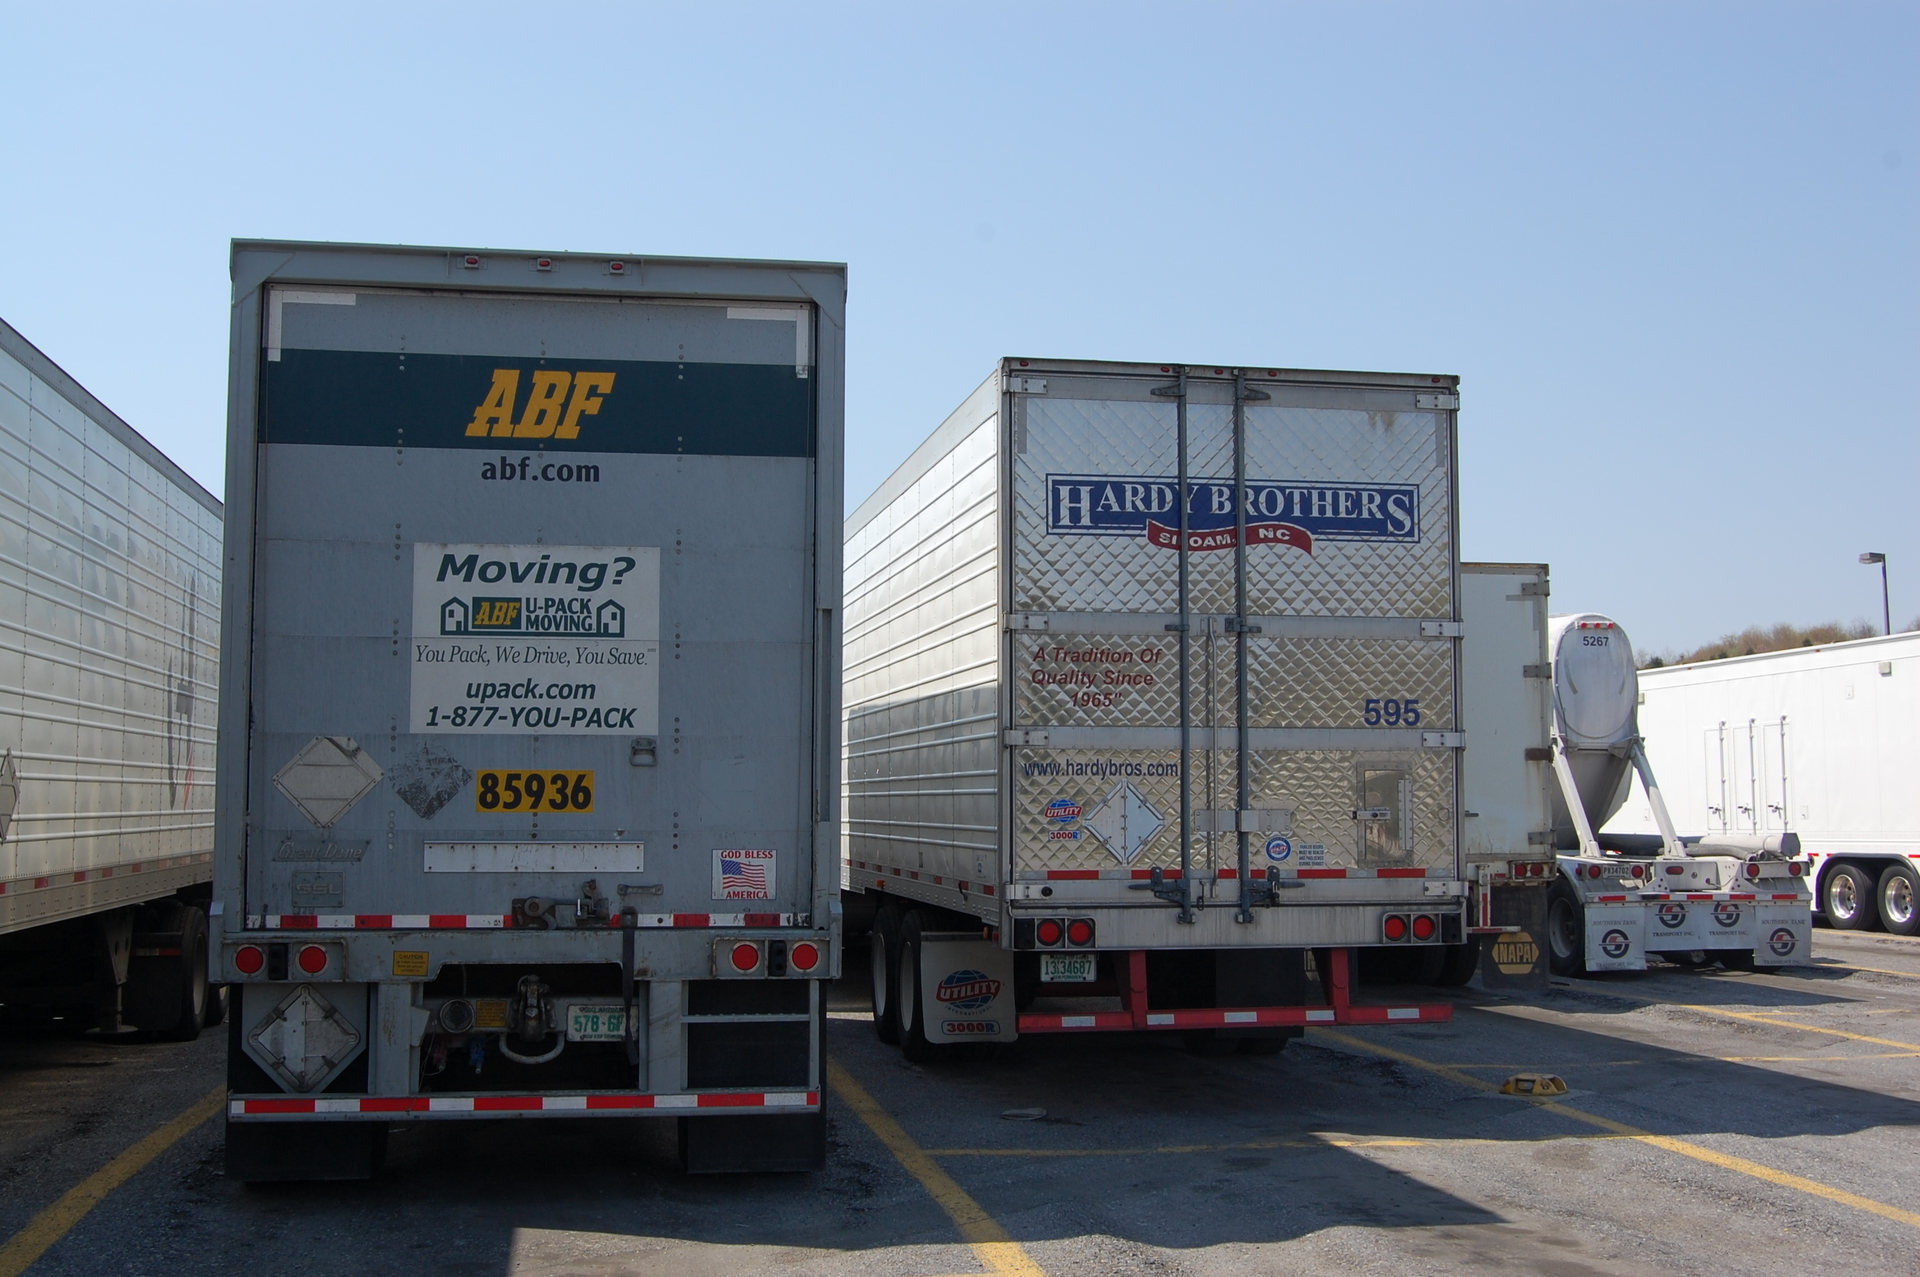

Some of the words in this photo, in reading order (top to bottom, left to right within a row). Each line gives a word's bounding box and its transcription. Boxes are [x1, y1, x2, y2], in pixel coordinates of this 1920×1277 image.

[465, 369, 616, 439] ABF
[481, 456, 600, 482] abf.com
[1055, 483, 1198, 527] HARDY
[1209, 485, 1411, 535] BROTHERS
[1158, 533, 1237, 548] SIOAM,
[1258, 528, 1291, 541] NC
[436, 554, 636, 592] Moving?
[474, 602, 521, 625] ABF
[525, 597, 592, 614] U-PACK
[525, 614, 593, 632] MOVING
[1582, 635, 1609, 646] 5267
[416, 645, 445, 663] You
[448, 645, 490, 667] Pack,
[495, 646, 520, 664] We
[523, 646, 571, 667] Drive,
[575, 647, 604, 665] You
[607, 648, 648, 666] Save.
[1032, 647, 1047, 662] A
[1052, 647, 1134, 664] Tradition
[1139, 648, 1162, 663] Of
[1031, 669, 1097, 689] Quality
[1102, 671, 1154, 686] Since
[466, 678, 596, 704] upack.com
[426, 706, 638, 729] 1-877-YOU-PACK
[1363, 699, 1421, 726] 595
[1024, 758, 1179, 781] www.hardybros.com
[478, 773, 593, 811] 85936
[1046, 807, 1081, 817] UTILITY
[1050, 831, 1079, 840] 3000R
[721, 850, 741, 859] GOD
[744, 850, 773, 859] BLESS
[726, 890, 768, 899] AMERICA
[1499, 943, 1532, 963] NAPA
[940, 981, 998, 999] UTILITY
[947, 1022, 996, 1033] 3000R
